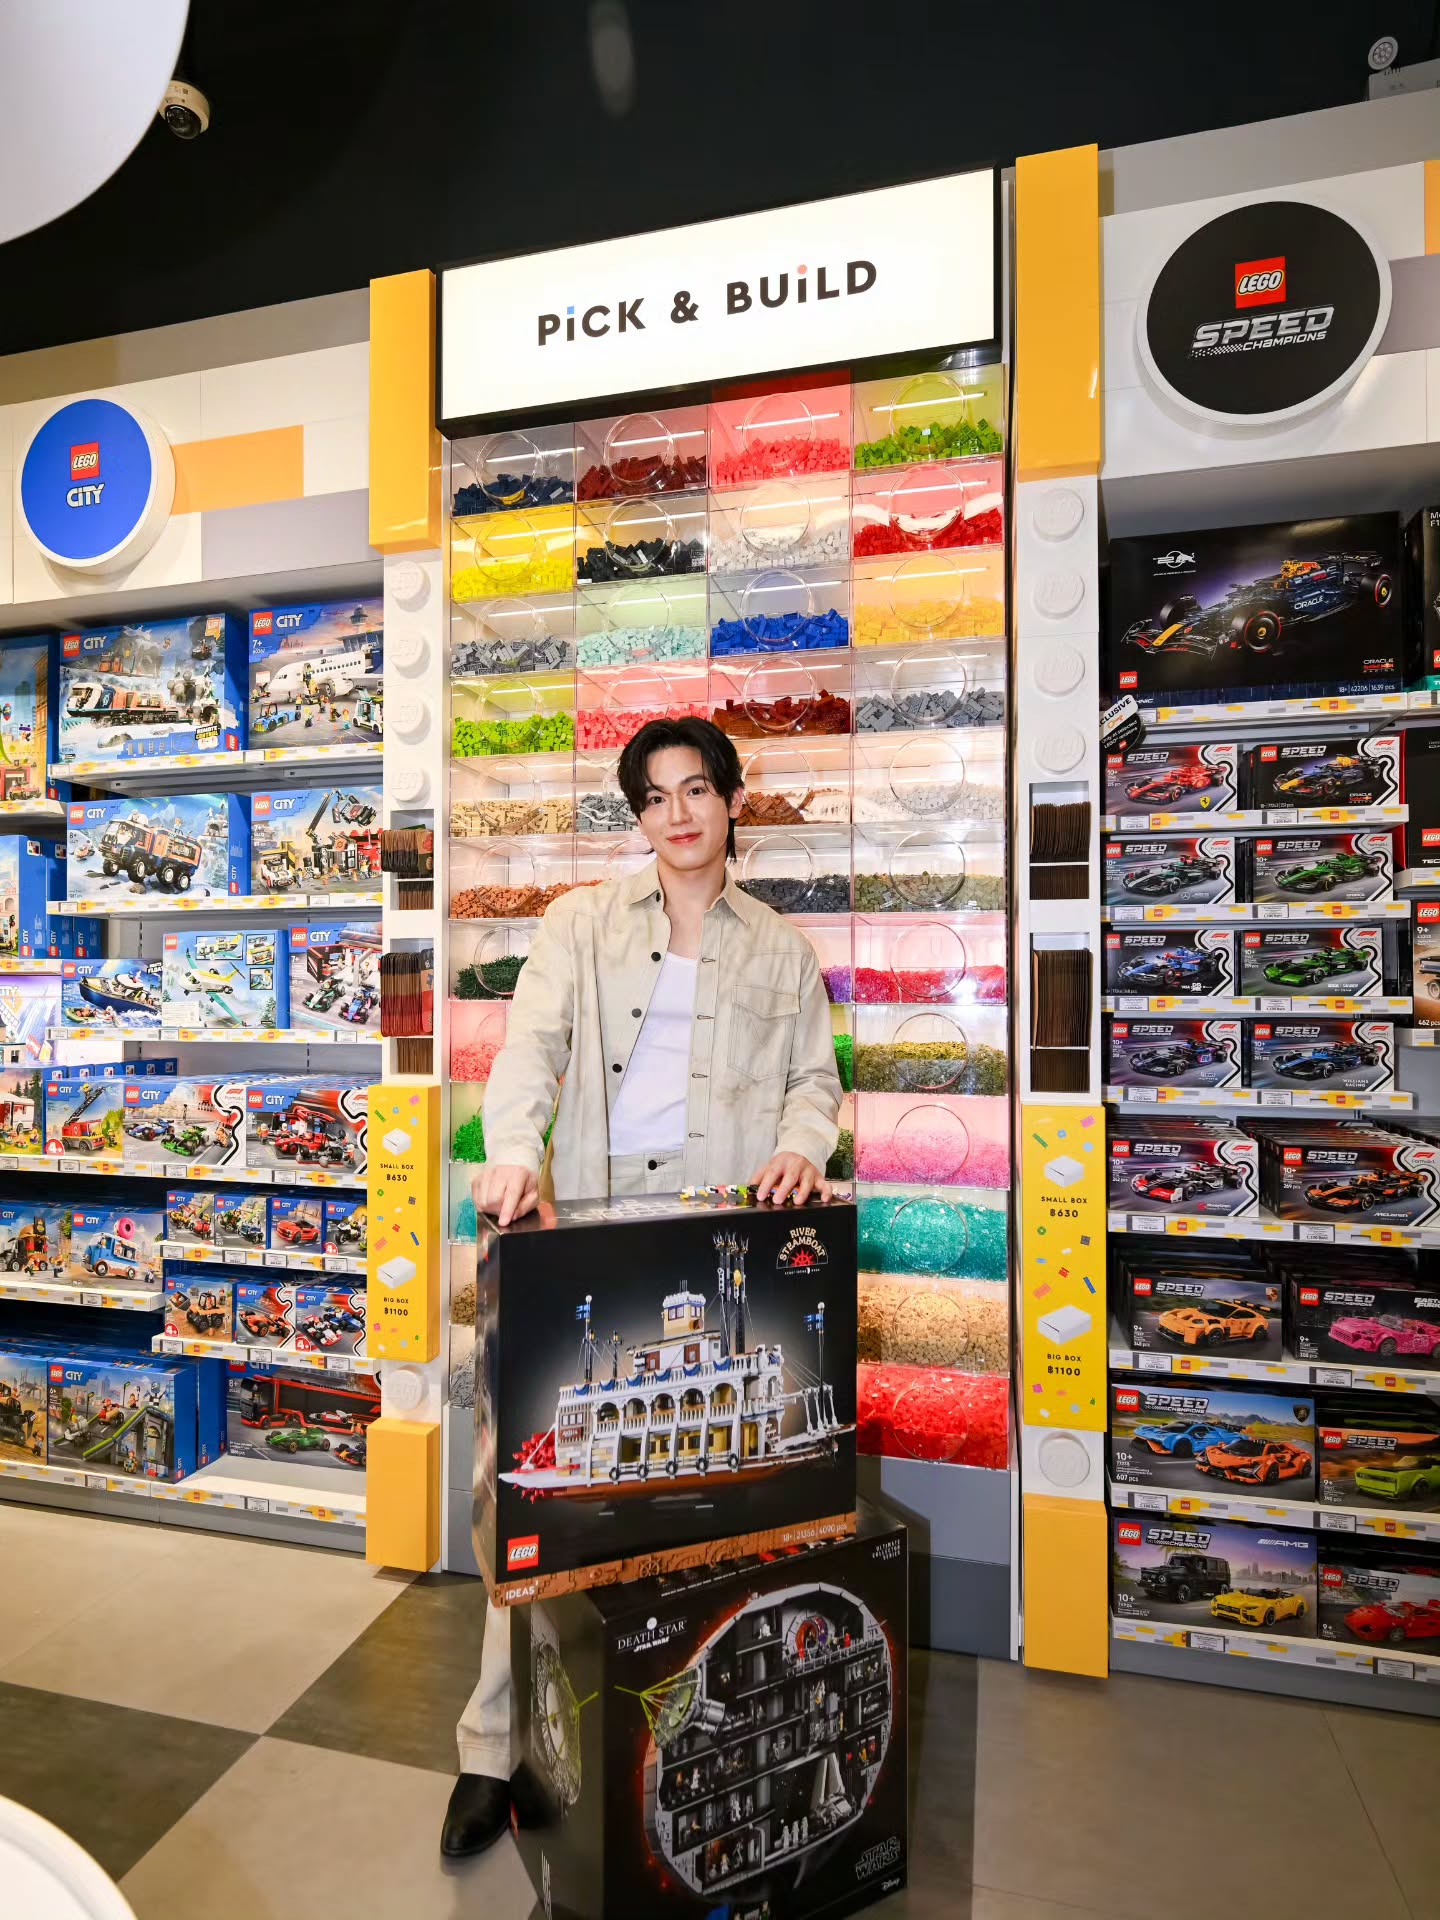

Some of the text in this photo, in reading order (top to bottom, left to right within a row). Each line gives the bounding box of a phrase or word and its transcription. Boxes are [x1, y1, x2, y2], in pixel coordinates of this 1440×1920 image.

[1237, 270, 1284, 295] LEGO
[671, 291, 698, 323] &
[1192, 305, 1334, 348] SPEED
[72, 453, 98, 470] LEGO
[66, 483, 105, 508] CITY
[1294, 596, 1323, 610] ORACLE
[254, 614, 303, 629] LEGO CITY
[64, 636, 107, 650] LEGO CITY
[252, 640, 262, 648] 7+
[1385, 683, 1395, 691] pcs
[1099, 698, 1131, 727] CLUSIVE
[1281, 746, 1327, 754] SPEED
[1127, 752, 1169, 761] SPEED
[255, 799, 295, 810] LEGO CITY
[70, 807, 108, 819] LEGO CITY
[1125, 844, 1167, 852] SPEED
[1277, 841, 1321, 849] SPEED
[1418, 908, 1439, 917] LEGO
[292, 931, 331, 943] LEGO CITY
[1264, 934, 1309, 942] SPEED
[78, 965, 93, 974] CITY
[1132, 1025, 1173, 1033] SPEED
[127, 1090, 160, 1100] LEGO CITY
[248, 1095, 285, 1105] LEGO CITY
[1134, 1144, 1181, 1152] SPEED
[1307, 1151, 1358, 1161] SPEED
[281, 1201, 291, 1209] CITY
[86, 1216, 100, 1224] CITY
[790, 1227, 816, 1238] RIVER
[779, 1237, 825, 1261] STEAMBOAT
[1156, 1282, 1204, 1293] SPEED
[1324, 1292, 1375, 1303] SPEED
[1047, 1353, 1081, 1362] BIG BOX
[66, 1371, 83, 1381] CITY
[1117, 1394, 1209, 1409] LEGO SPEED
[1347, 1435, 1397, 1445] SPEED
[1116, 1452, 1133, 1461] 10+
[836, 1523, 847, 1532] pcs
[1119, 1528, 1210, 1544] LEGO SPEED
[1275, 1540, 1309, 1548] AMG
[510, 1544, 537, 1560] LEGO
[1347, 1574, 1400, 1587] SPEED
[506, 1586, 534, 1600] IDEAS
[1118, 1594, 1135, 1602] 10+
[618, 1621, 687, 1650] DEATH STAR
[862, 1836, 901, 1861] STAR
[856, 1850, 898, 1881] WARS
